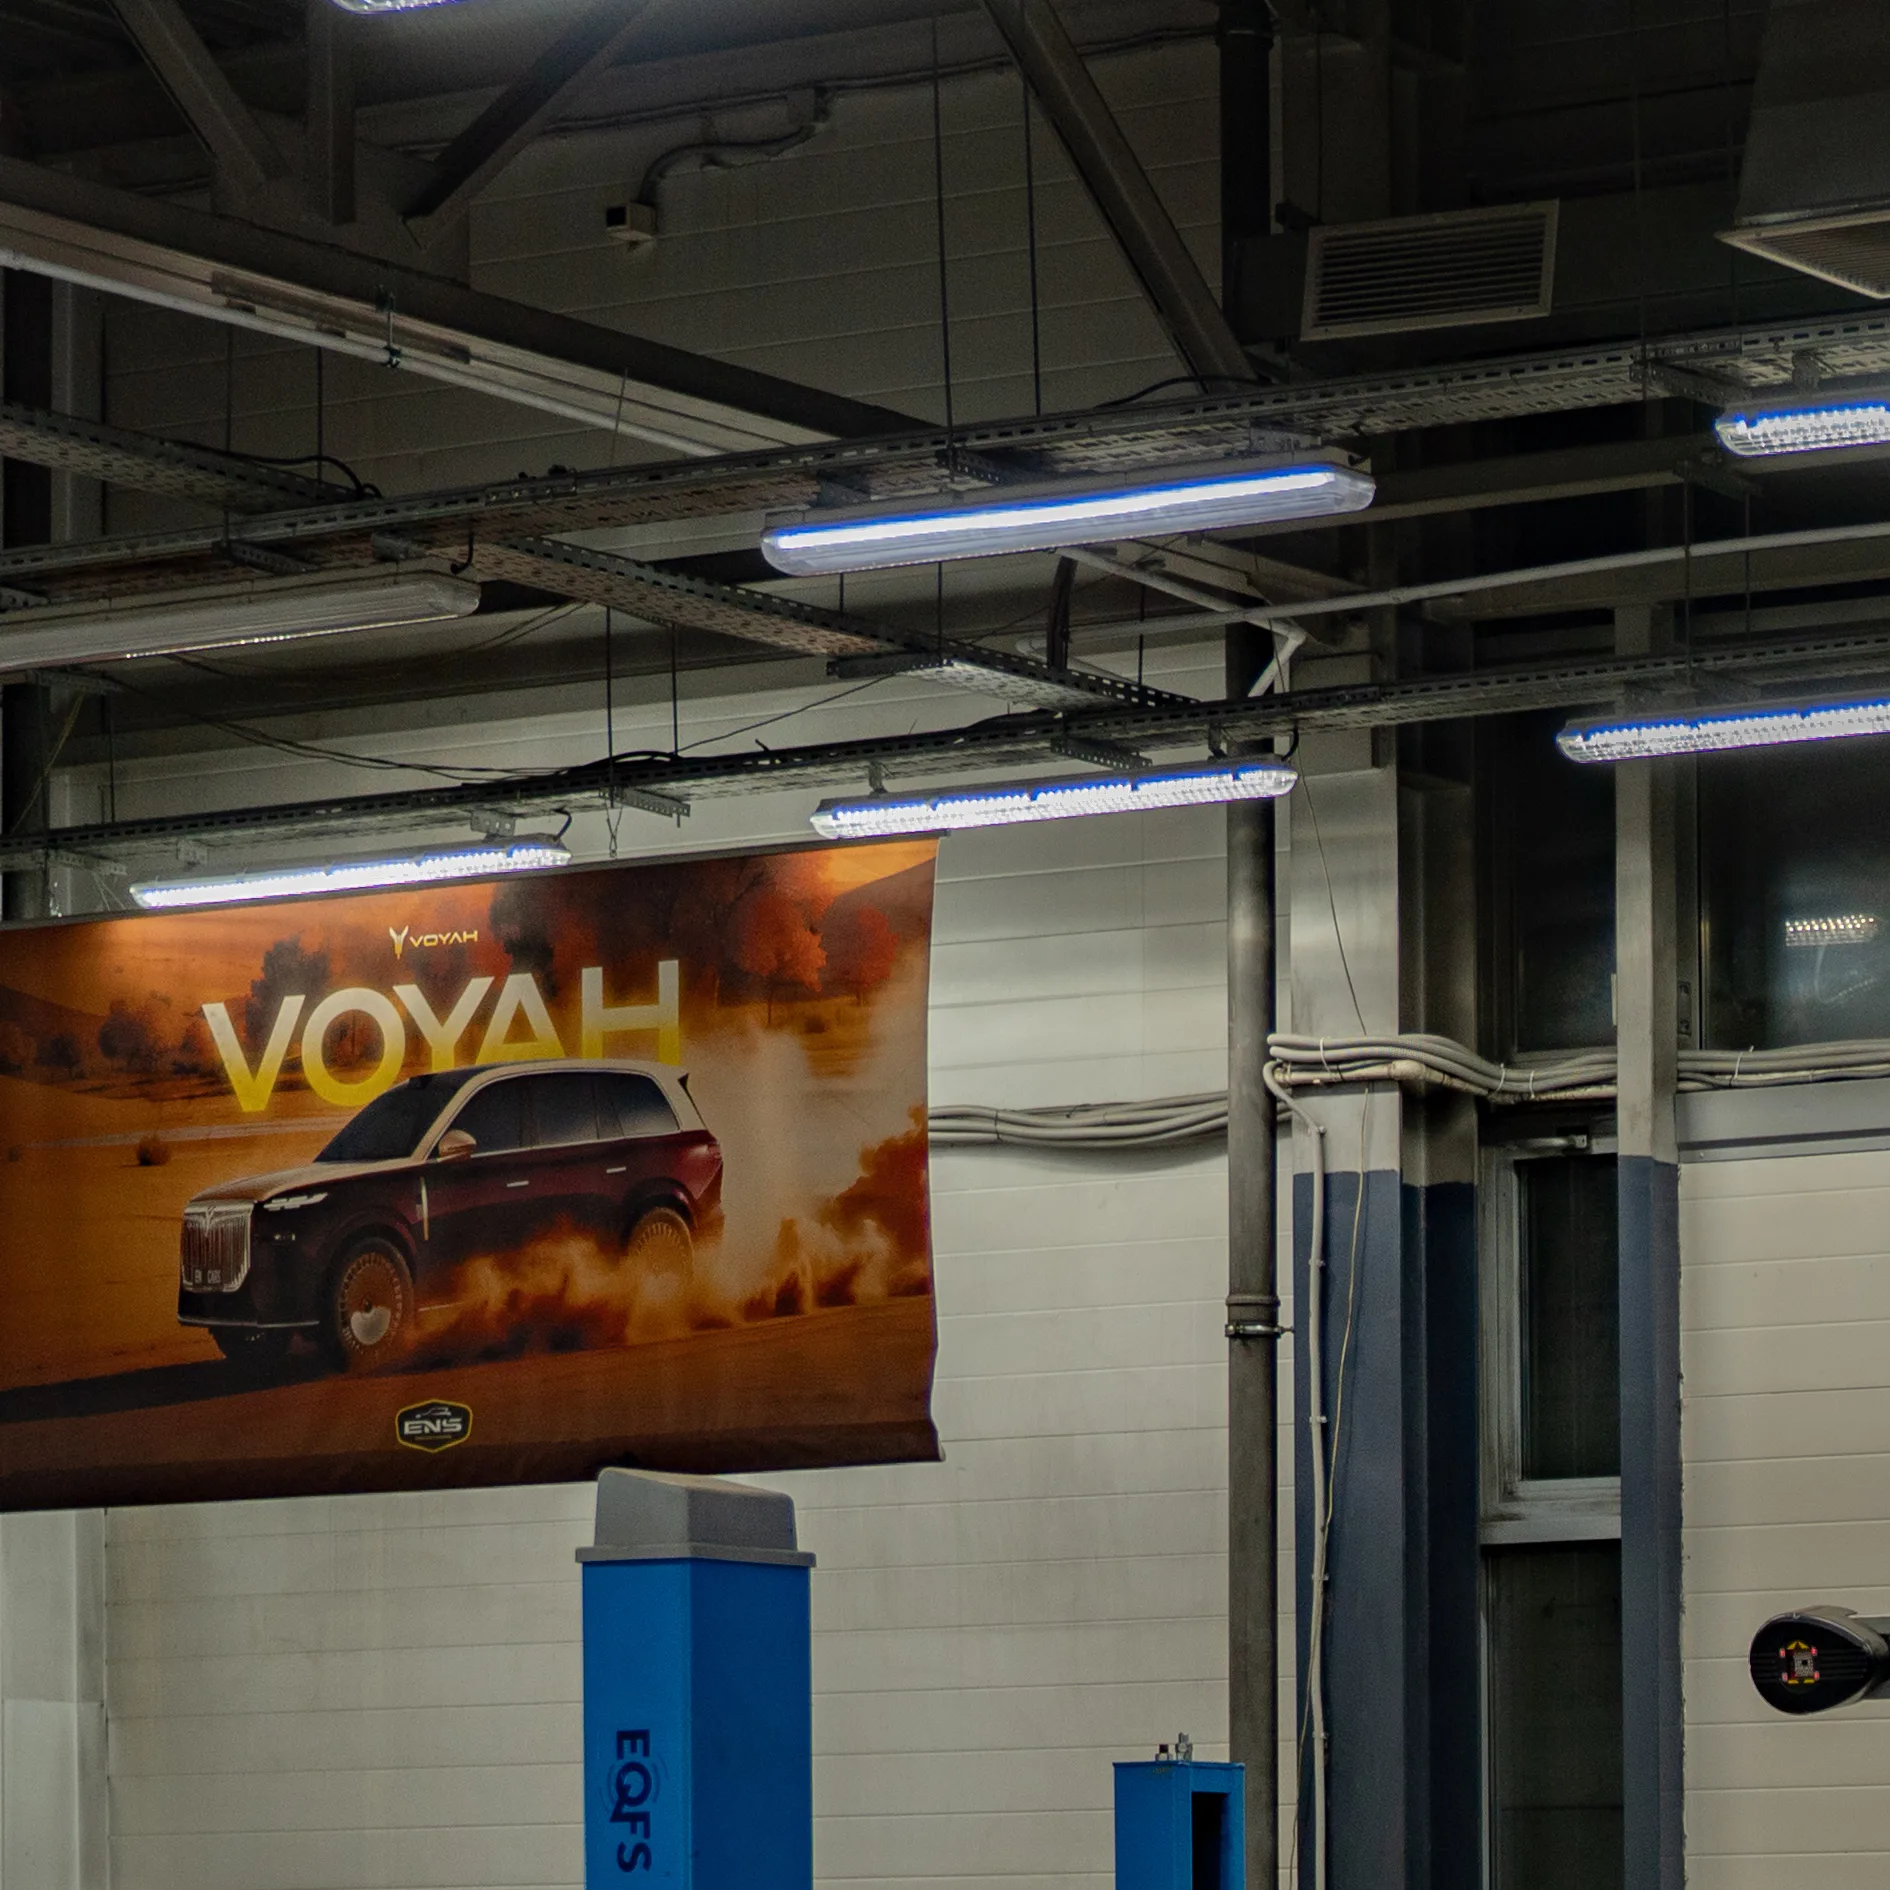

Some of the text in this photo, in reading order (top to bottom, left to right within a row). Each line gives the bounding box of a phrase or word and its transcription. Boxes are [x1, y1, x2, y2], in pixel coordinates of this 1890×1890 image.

[409, 930, 478, 947] VOYAH
[201, 959, 680, 1112] VOYAH
[404, 1417, 462, 1435] ENS
[609, 1729, 652, 1873] EQFS
